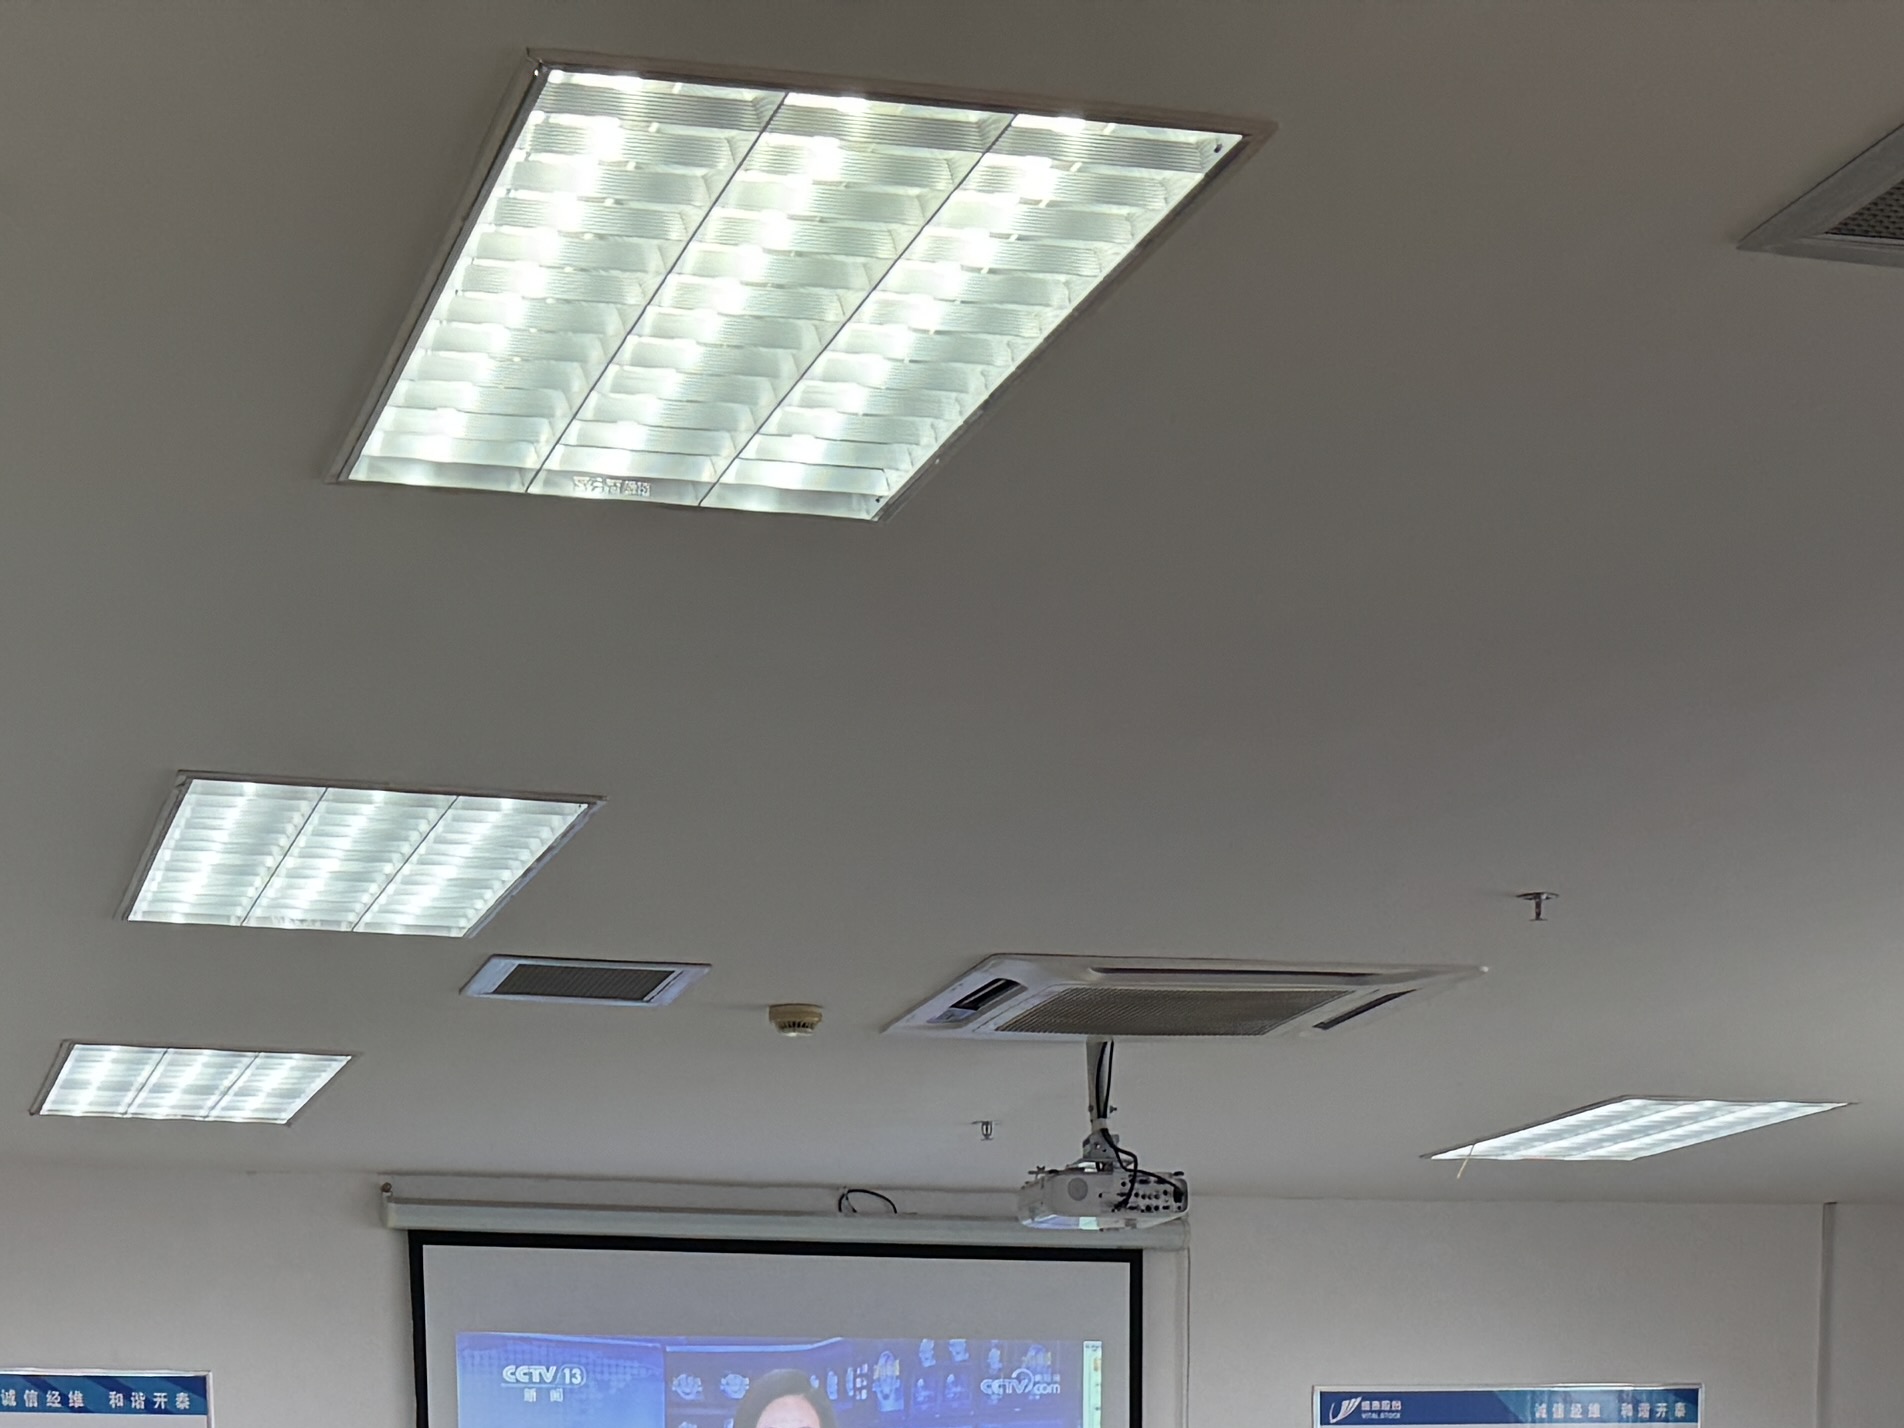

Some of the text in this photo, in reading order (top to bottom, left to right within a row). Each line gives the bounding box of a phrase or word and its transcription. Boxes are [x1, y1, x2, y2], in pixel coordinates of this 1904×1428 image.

[502, 1364, 582, 1385] CCTV 13
[0, 1388, 191, 1411] 诚信经维 和谐开泰
